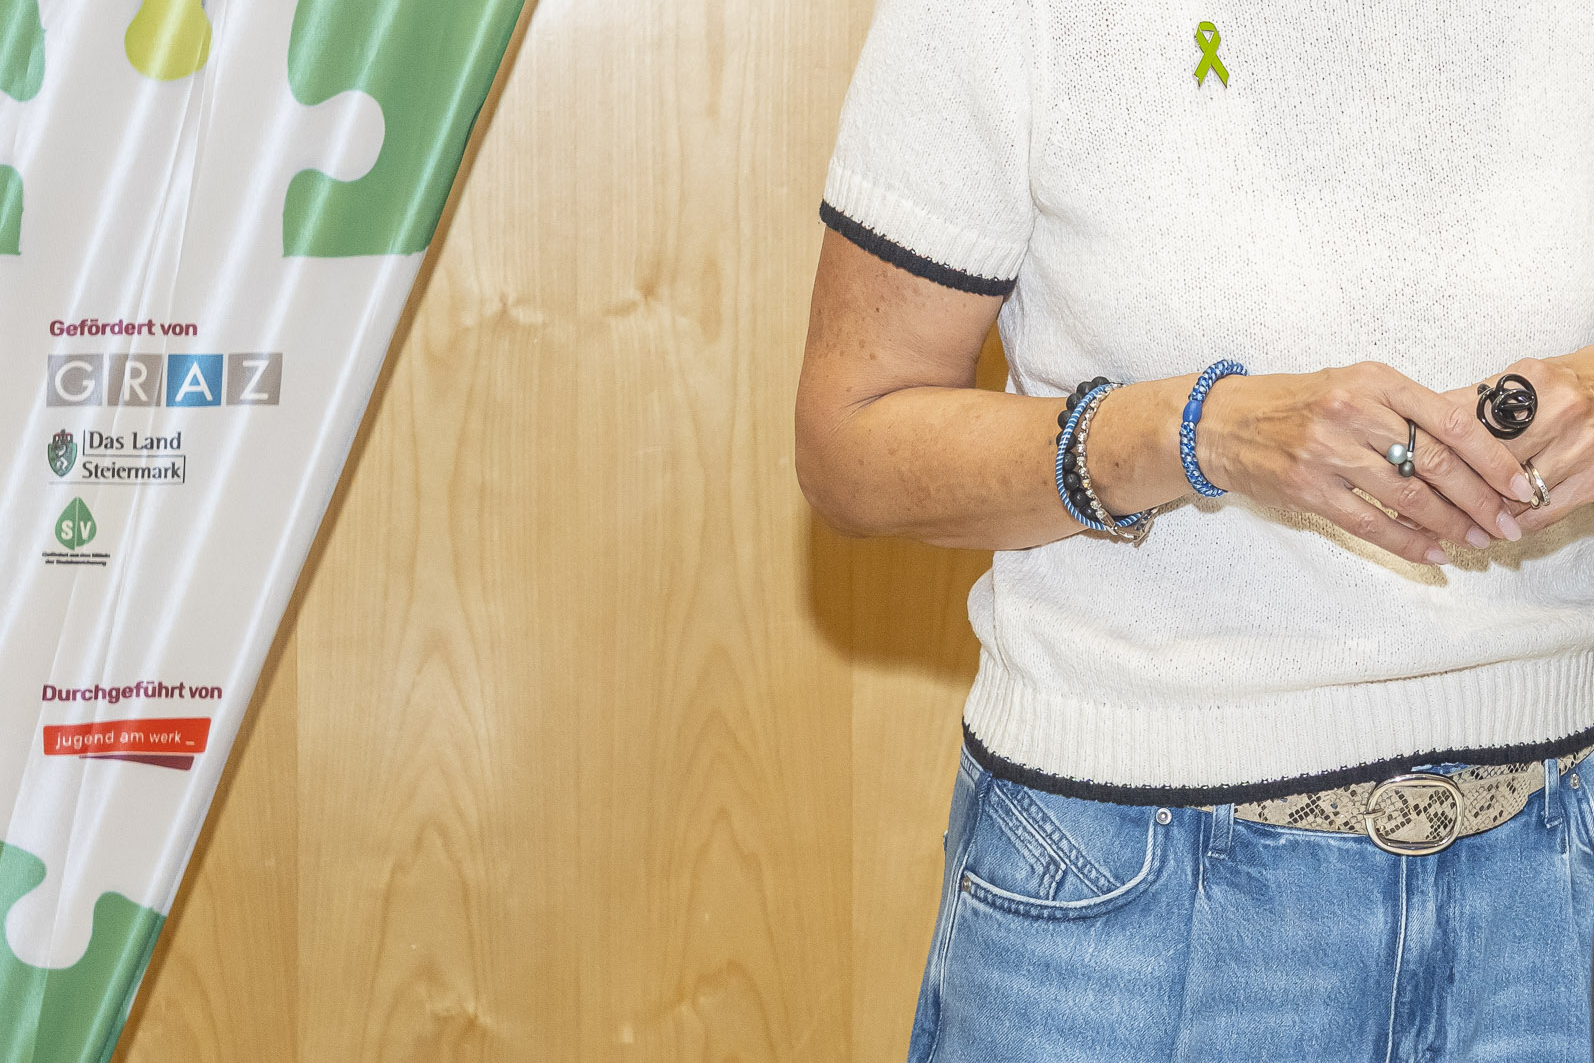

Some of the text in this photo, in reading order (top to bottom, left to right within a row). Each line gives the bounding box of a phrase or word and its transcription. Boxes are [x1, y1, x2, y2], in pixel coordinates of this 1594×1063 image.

[50, 319, 198, 337] Gefördert von
[55, 358, 270, 402] GRAZ
[89, 431, 182, 450] Das Land
[82, 461, 181, 480] Steiermark
[42, 681, 222, 704] Durchgeführt von
[56, 730, 181, 749] jugend am werk
